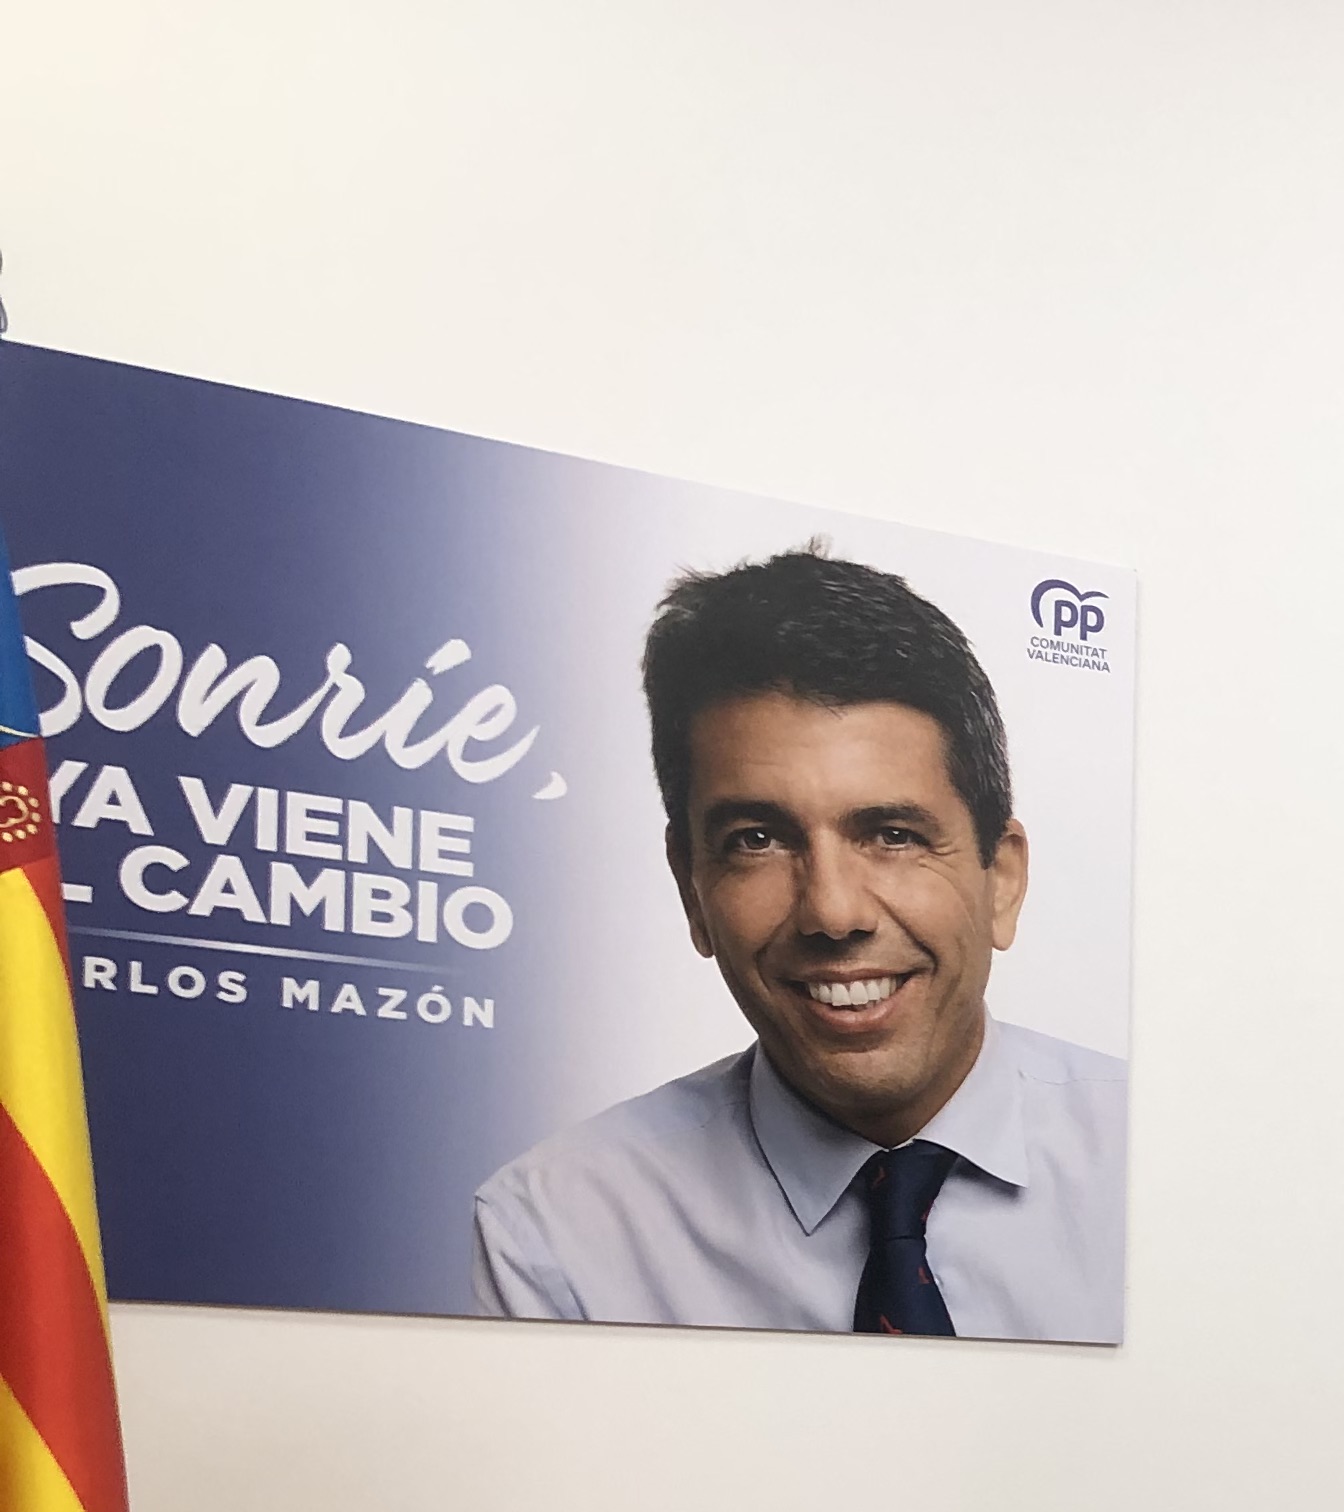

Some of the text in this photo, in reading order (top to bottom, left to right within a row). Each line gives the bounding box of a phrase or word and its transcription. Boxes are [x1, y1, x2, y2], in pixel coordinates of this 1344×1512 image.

[1026, 648, 1111, 673] VALENCIANA
[1030, 636, 1108, 660] COMUNITAT
[178, 775, 475, 878] VIENE
[119, 844, 514, 951] CAMBIO
[83, 955, 496, 1029] RLOS MAZÓN
